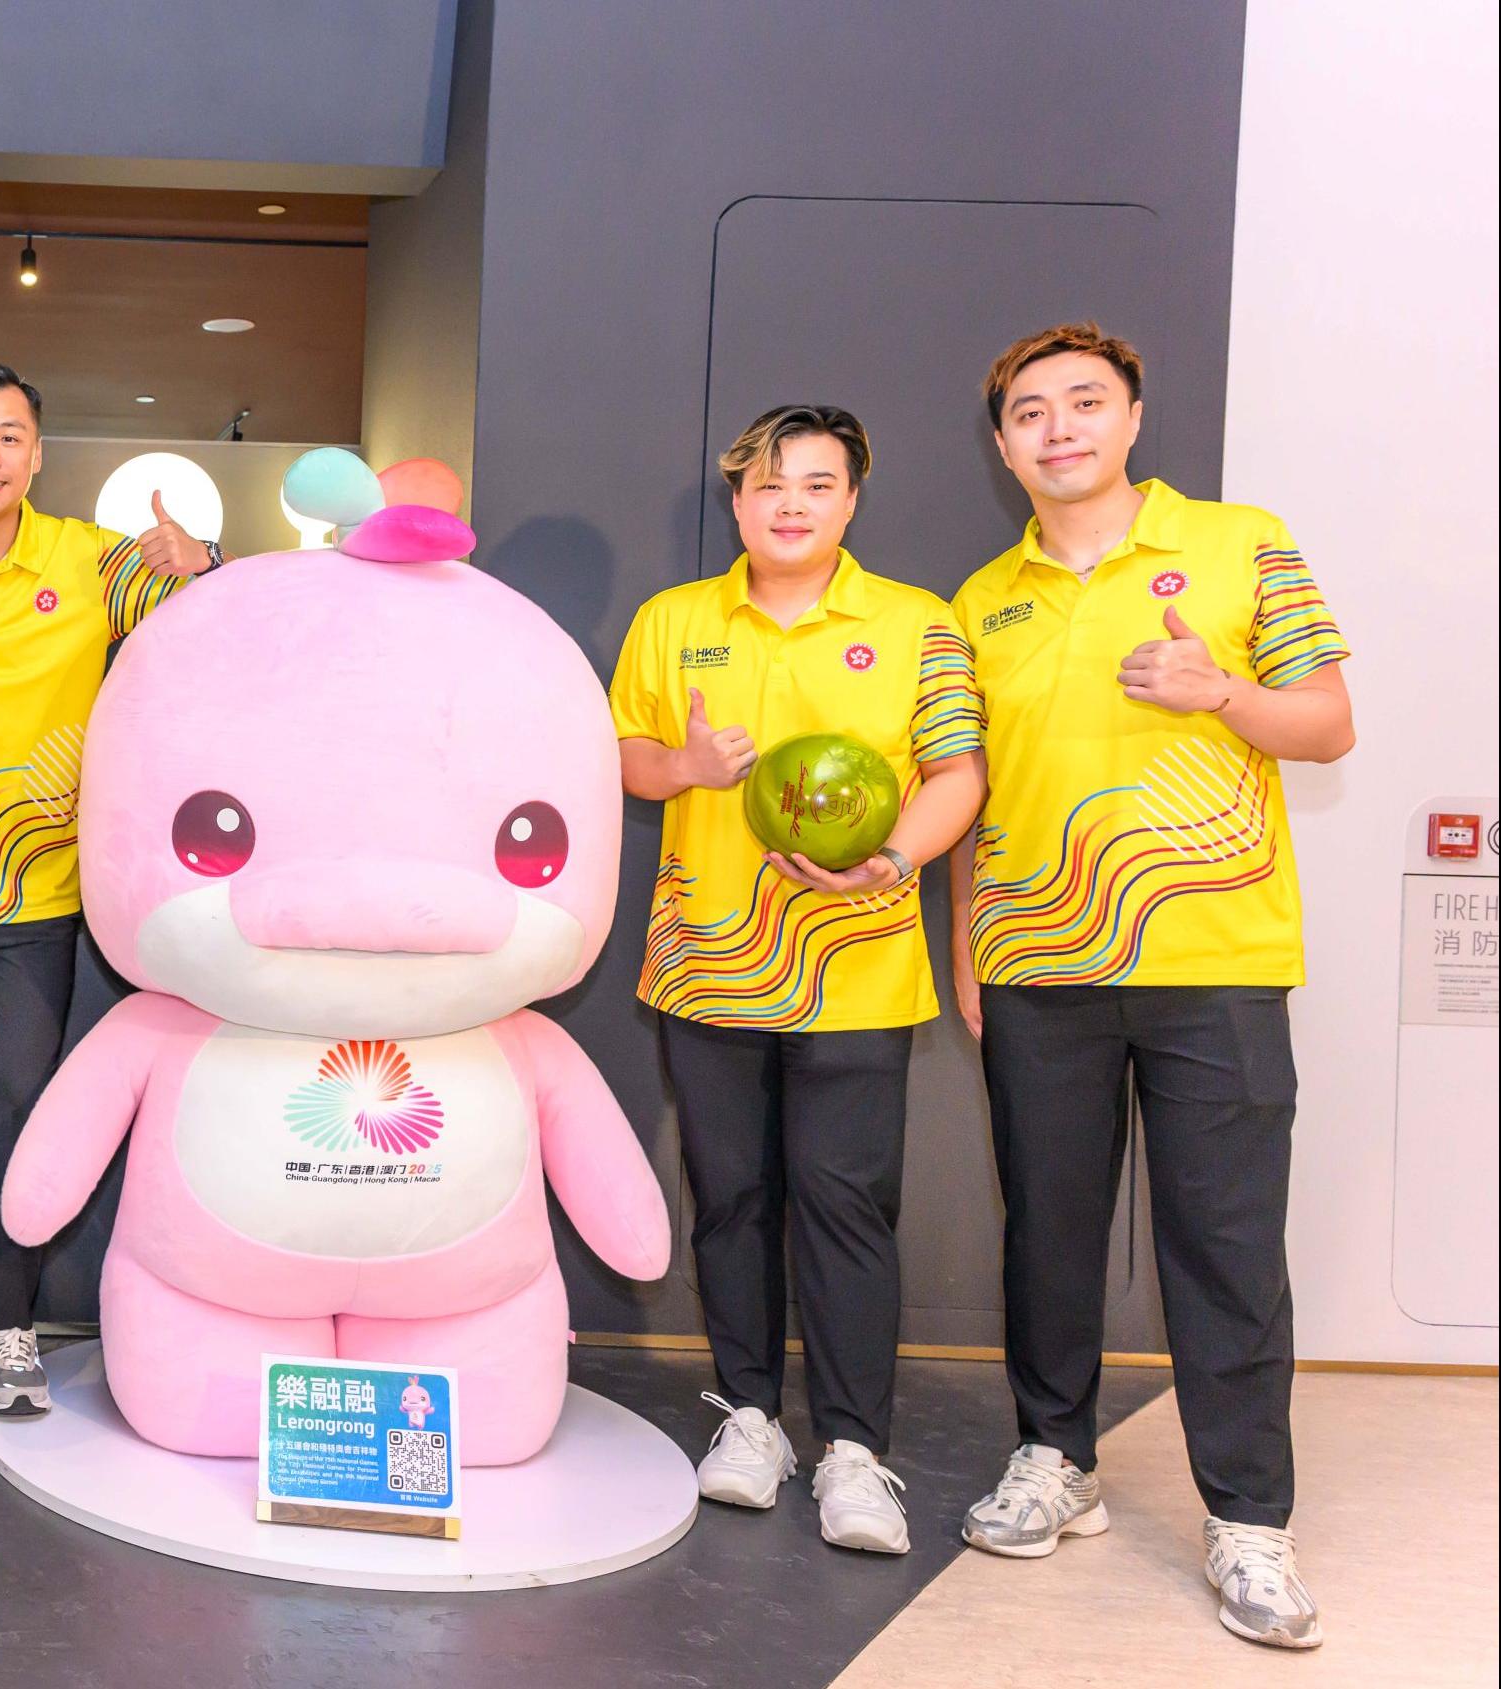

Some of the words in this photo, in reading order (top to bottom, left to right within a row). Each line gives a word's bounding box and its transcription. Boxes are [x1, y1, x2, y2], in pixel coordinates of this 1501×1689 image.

[1433, 893, 1480, 921] FIRE
[1434, 929, 1498, 957] 消防
[365, 1176, 386, 1185] Hong
[388, 1176, 409, 1185] Kong
[414, 1175, 441, 1183] Macao
[276, 1374, 377, 1414] 樂融融
[277, 1413, 375, 1438] Lerongrong
